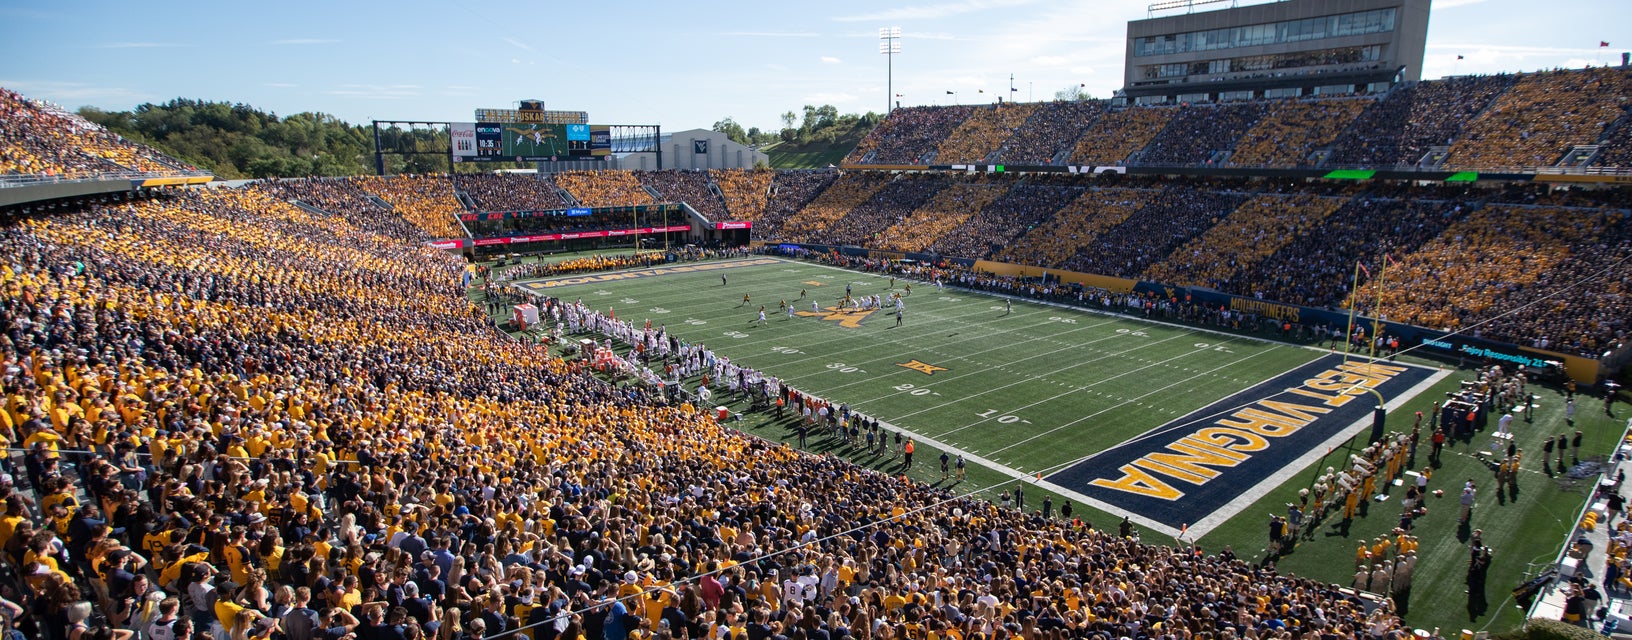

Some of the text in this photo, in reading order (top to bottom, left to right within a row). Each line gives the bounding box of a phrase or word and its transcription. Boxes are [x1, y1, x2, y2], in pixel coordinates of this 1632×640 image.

[514, 111, 545, 121] PUSKAR
[1484, 349, 1531, 366] Responsibly
[826, 362, 859, 373] 30
[892, 383, 931, 397] 20
[1284, 360, 1408, 407] WEST
[975, 408, 1020, 424] 10
[1087, 399, 1334, 501] VIRGINIA
[147, 540, 162, 552] 19
[789, 586, 796, 595] 8
